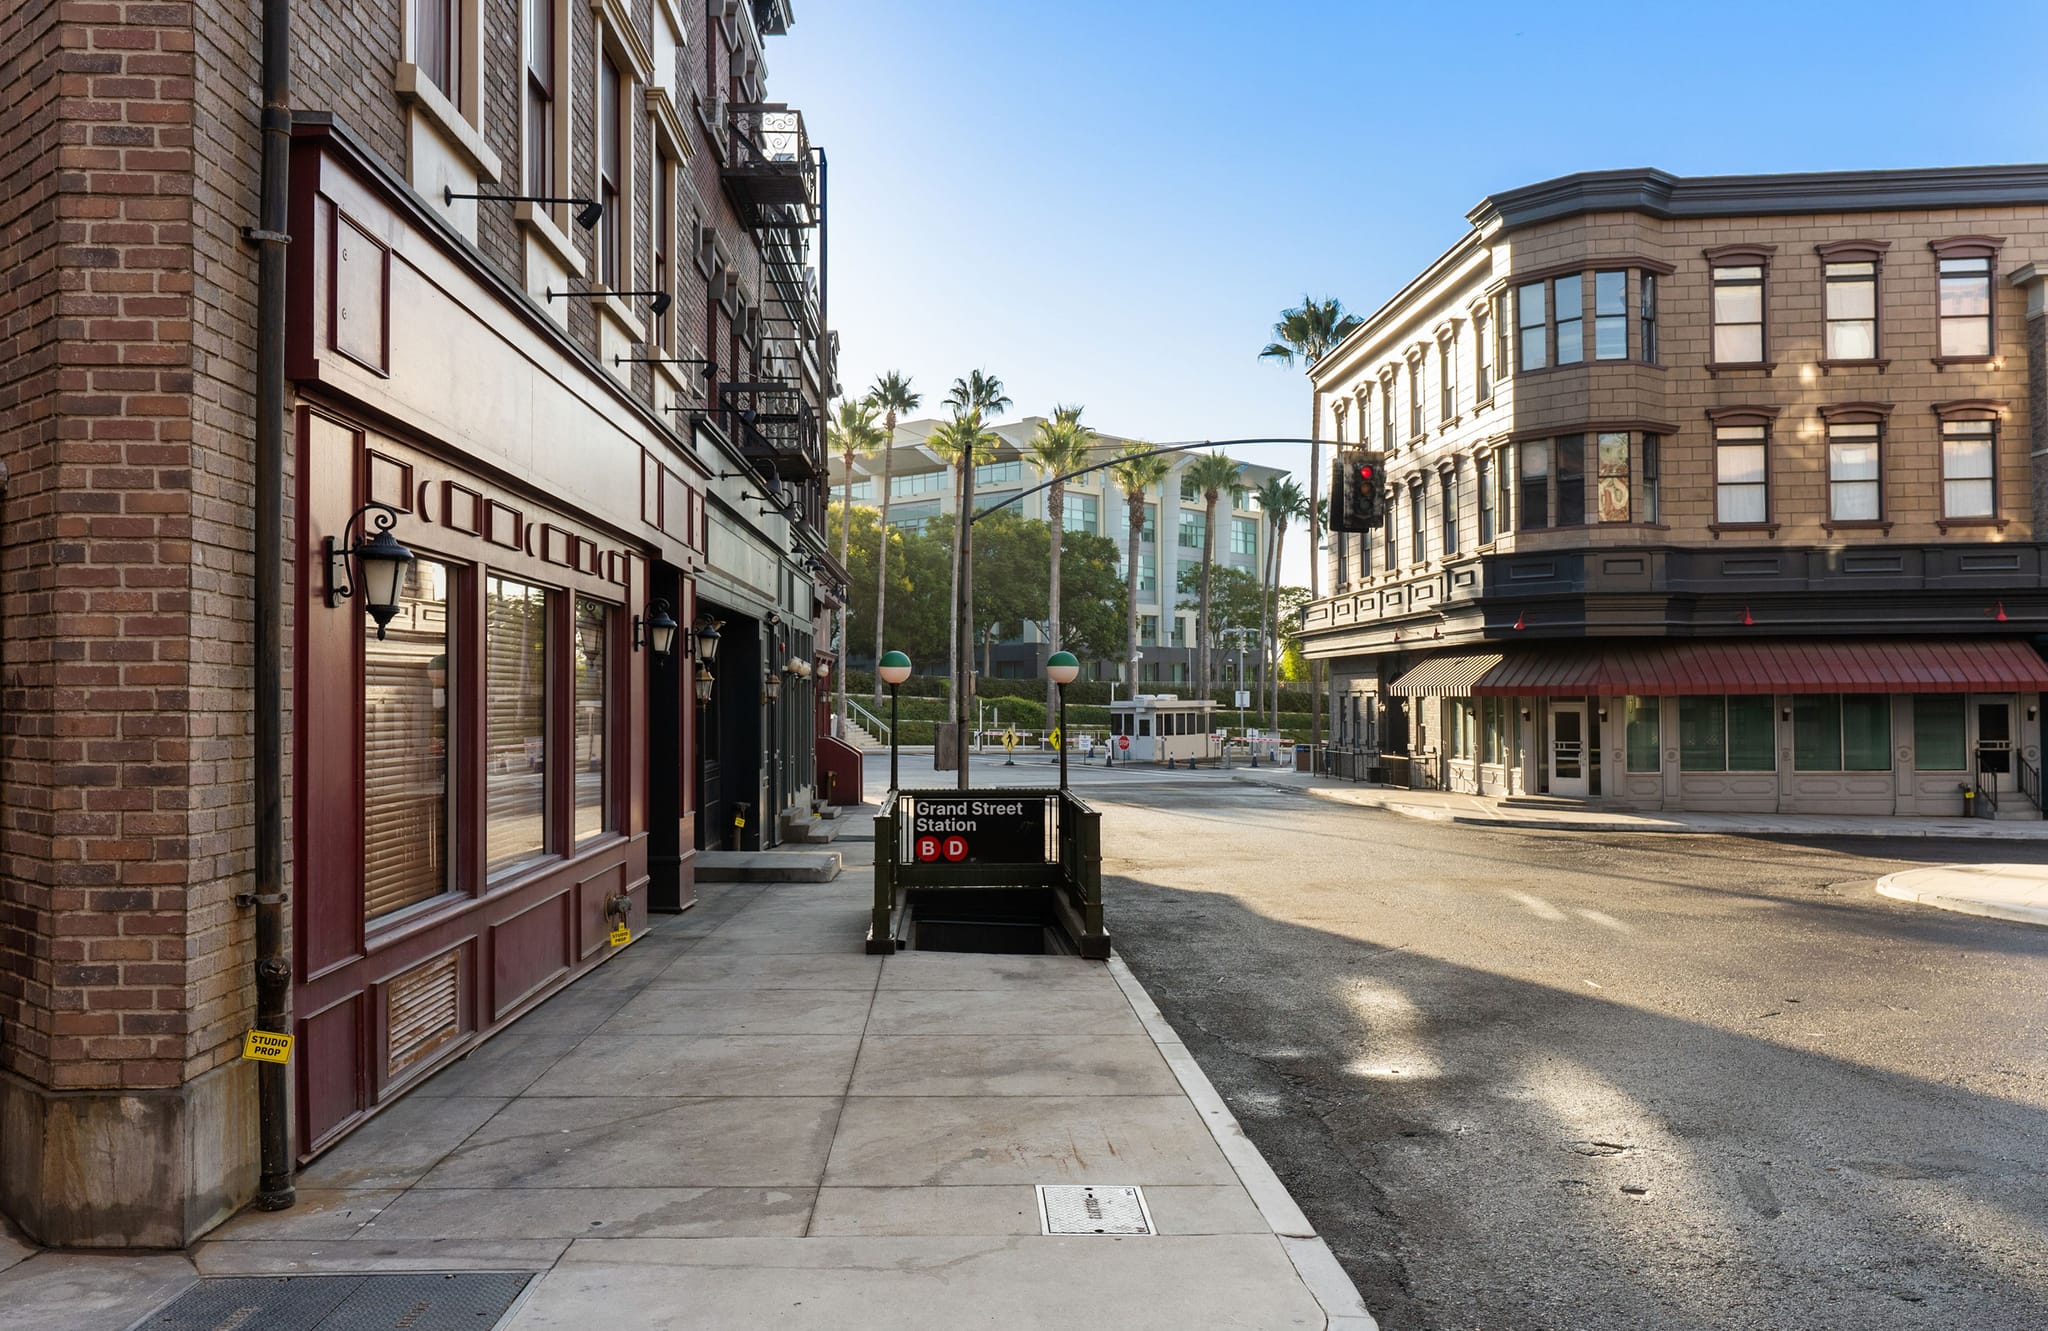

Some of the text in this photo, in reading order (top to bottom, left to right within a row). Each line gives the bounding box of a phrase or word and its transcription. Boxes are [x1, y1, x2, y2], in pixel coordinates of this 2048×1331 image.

[916, 801, 1023, 816] Grand Street
[916, 817, 977, 832] Station
[922, 840, 963, 856] B D
[251, 1035, 288, 1048] STUDIO
[254, 1046, 281, 1056] PROP
